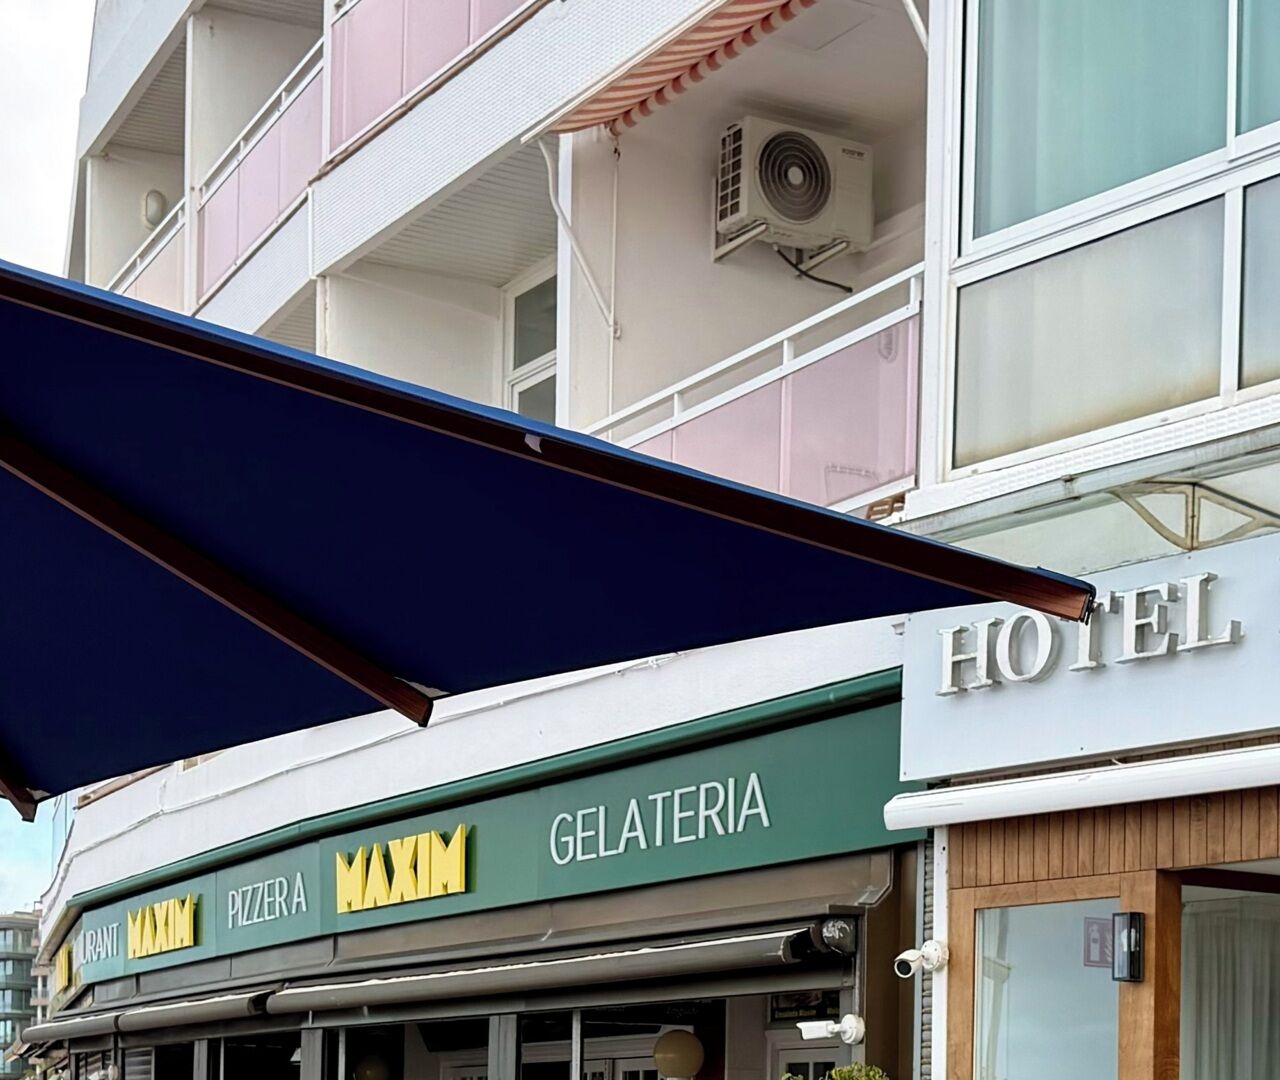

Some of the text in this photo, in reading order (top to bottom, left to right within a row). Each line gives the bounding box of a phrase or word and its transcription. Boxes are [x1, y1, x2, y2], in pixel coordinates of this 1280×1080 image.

[936, 572, 1245, 697] HOTEL
[127, 891, 195, 960] MAXIM
[335, 823, 469, 915] MAXIM
[549, 773, 771, 866] GELATERIA
